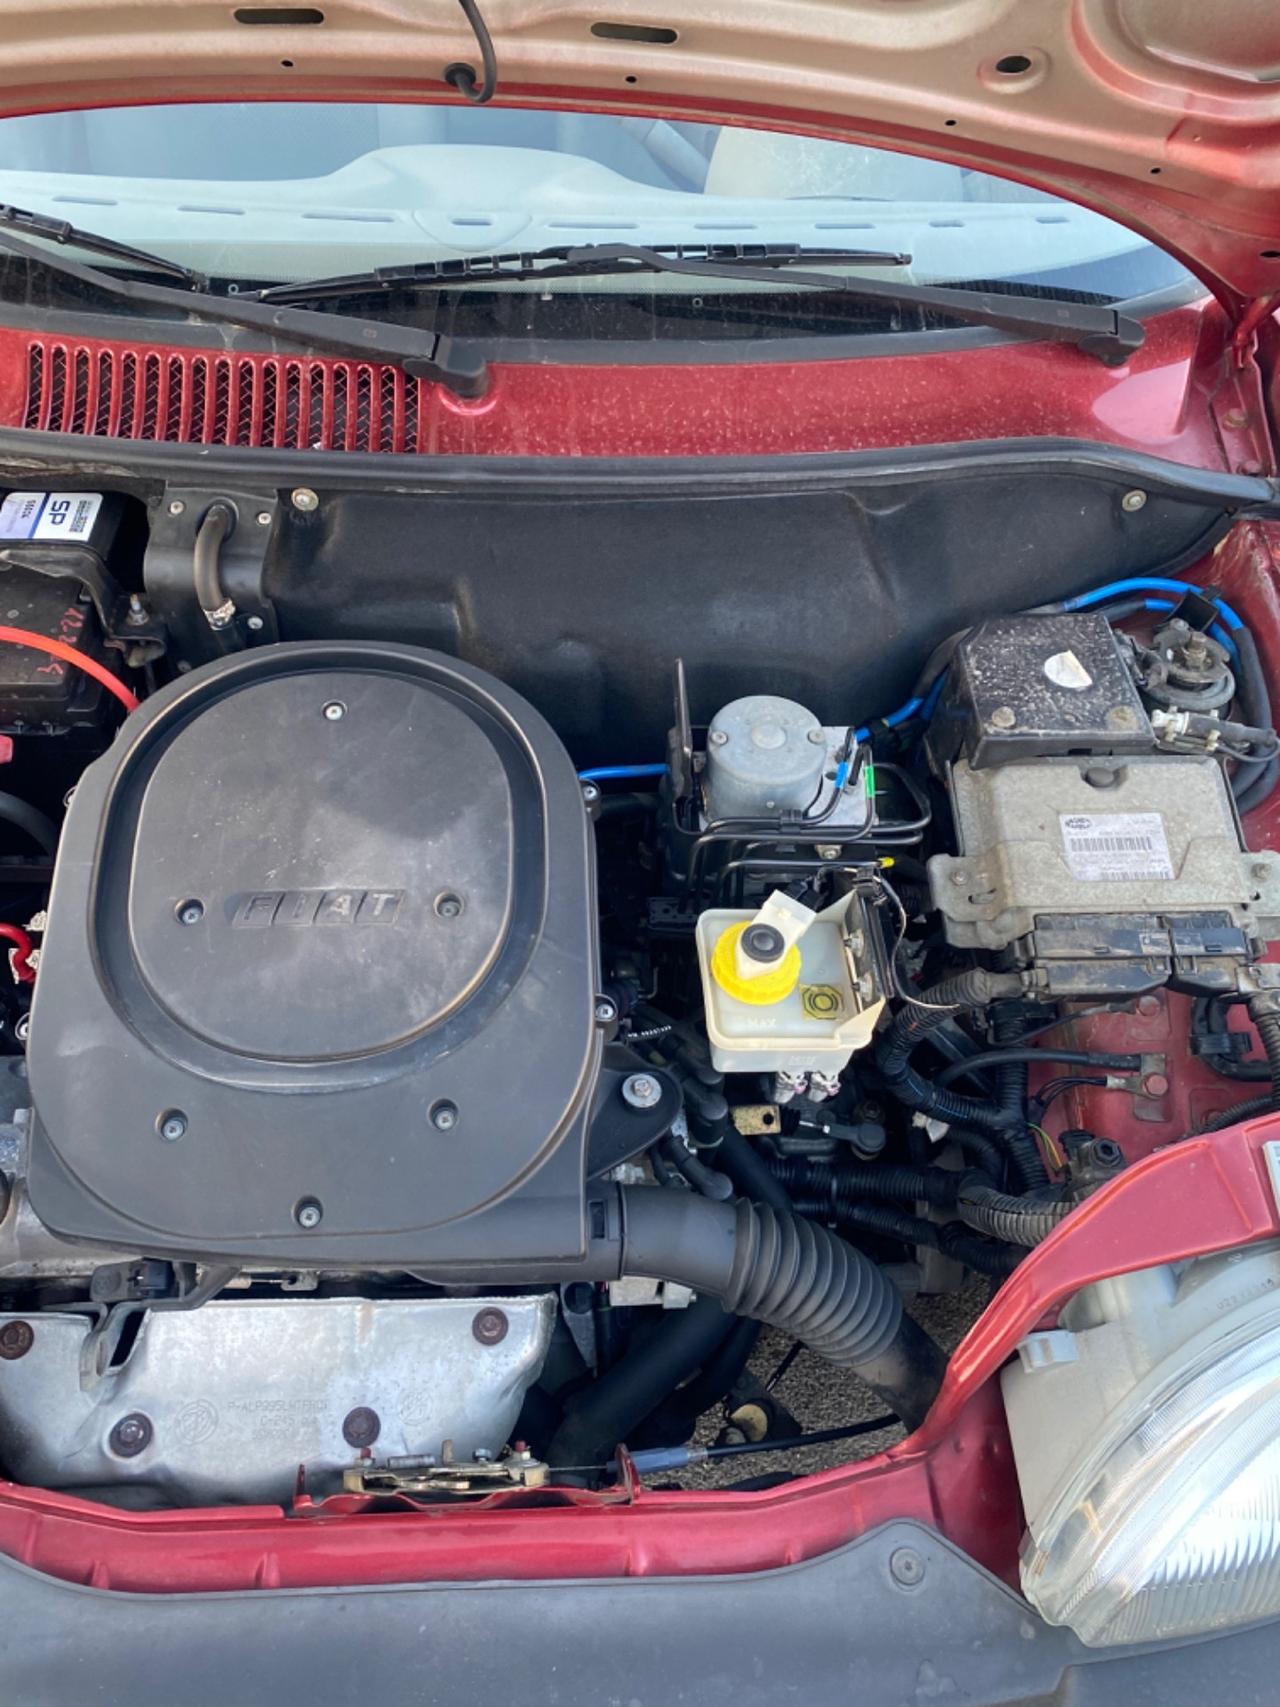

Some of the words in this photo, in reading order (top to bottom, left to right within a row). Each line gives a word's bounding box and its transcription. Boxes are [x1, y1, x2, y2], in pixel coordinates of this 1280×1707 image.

[49, 500, 70, 526] SP
[242, 893, 397, 921] FIAT
[747, 1016, 777, 1029] MAX
